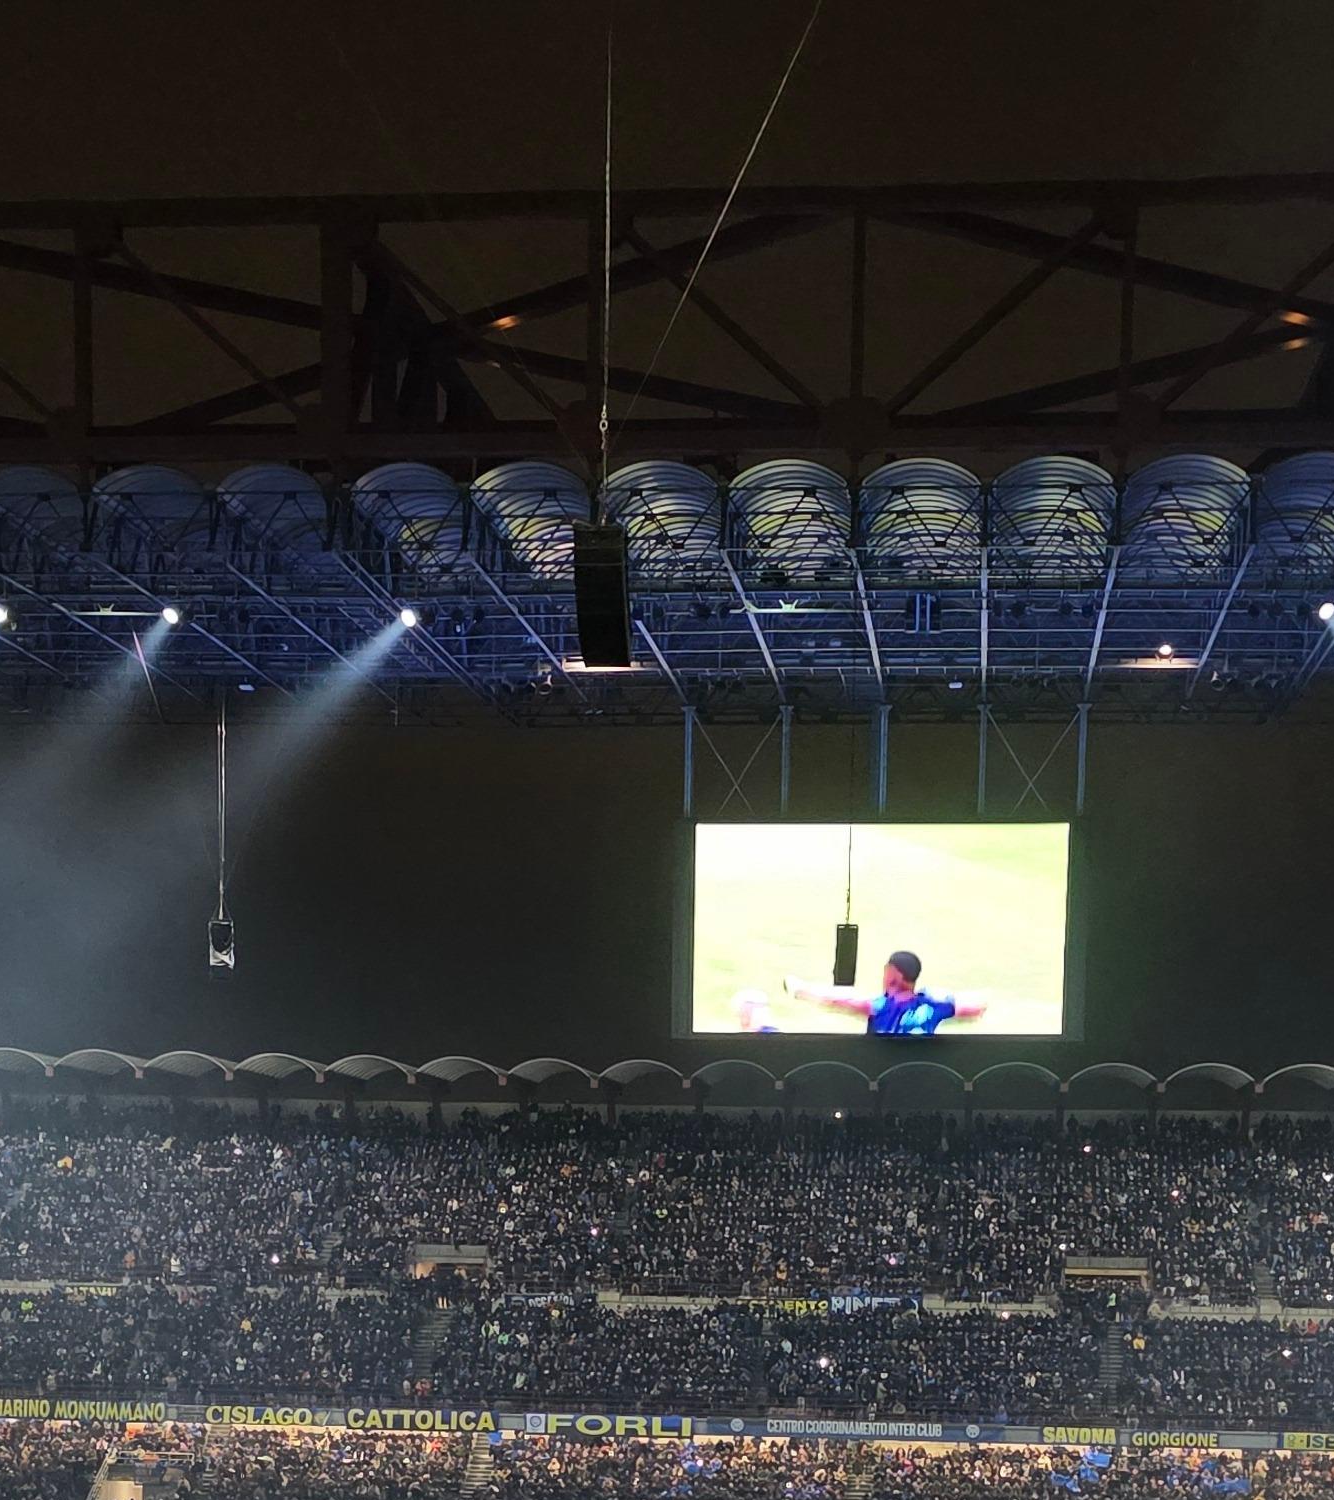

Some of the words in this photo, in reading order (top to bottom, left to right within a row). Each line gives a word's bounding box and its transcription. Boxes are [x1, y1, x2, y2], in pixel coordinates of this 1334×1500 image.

[54, 1399, 165, 1421] MONSUMMANO
[206, 1406, 313, 1425] CISLAGO
[347, 1410, 496, 1431] CATTOLICA
[547, 1415, 692, 1437] FORLI
[766, 1419, 805, 1434] CENTRO
[805, 1420, 887, 1436] COORDINAMENTO
[888, 1422, 916, 1436] INTER
[916, 1422, 943, 1437] CLUB
[1042, 1426, 1117, 1444] SAVONA
[1131, 1432, 1218, 1448] GIORGIONE
